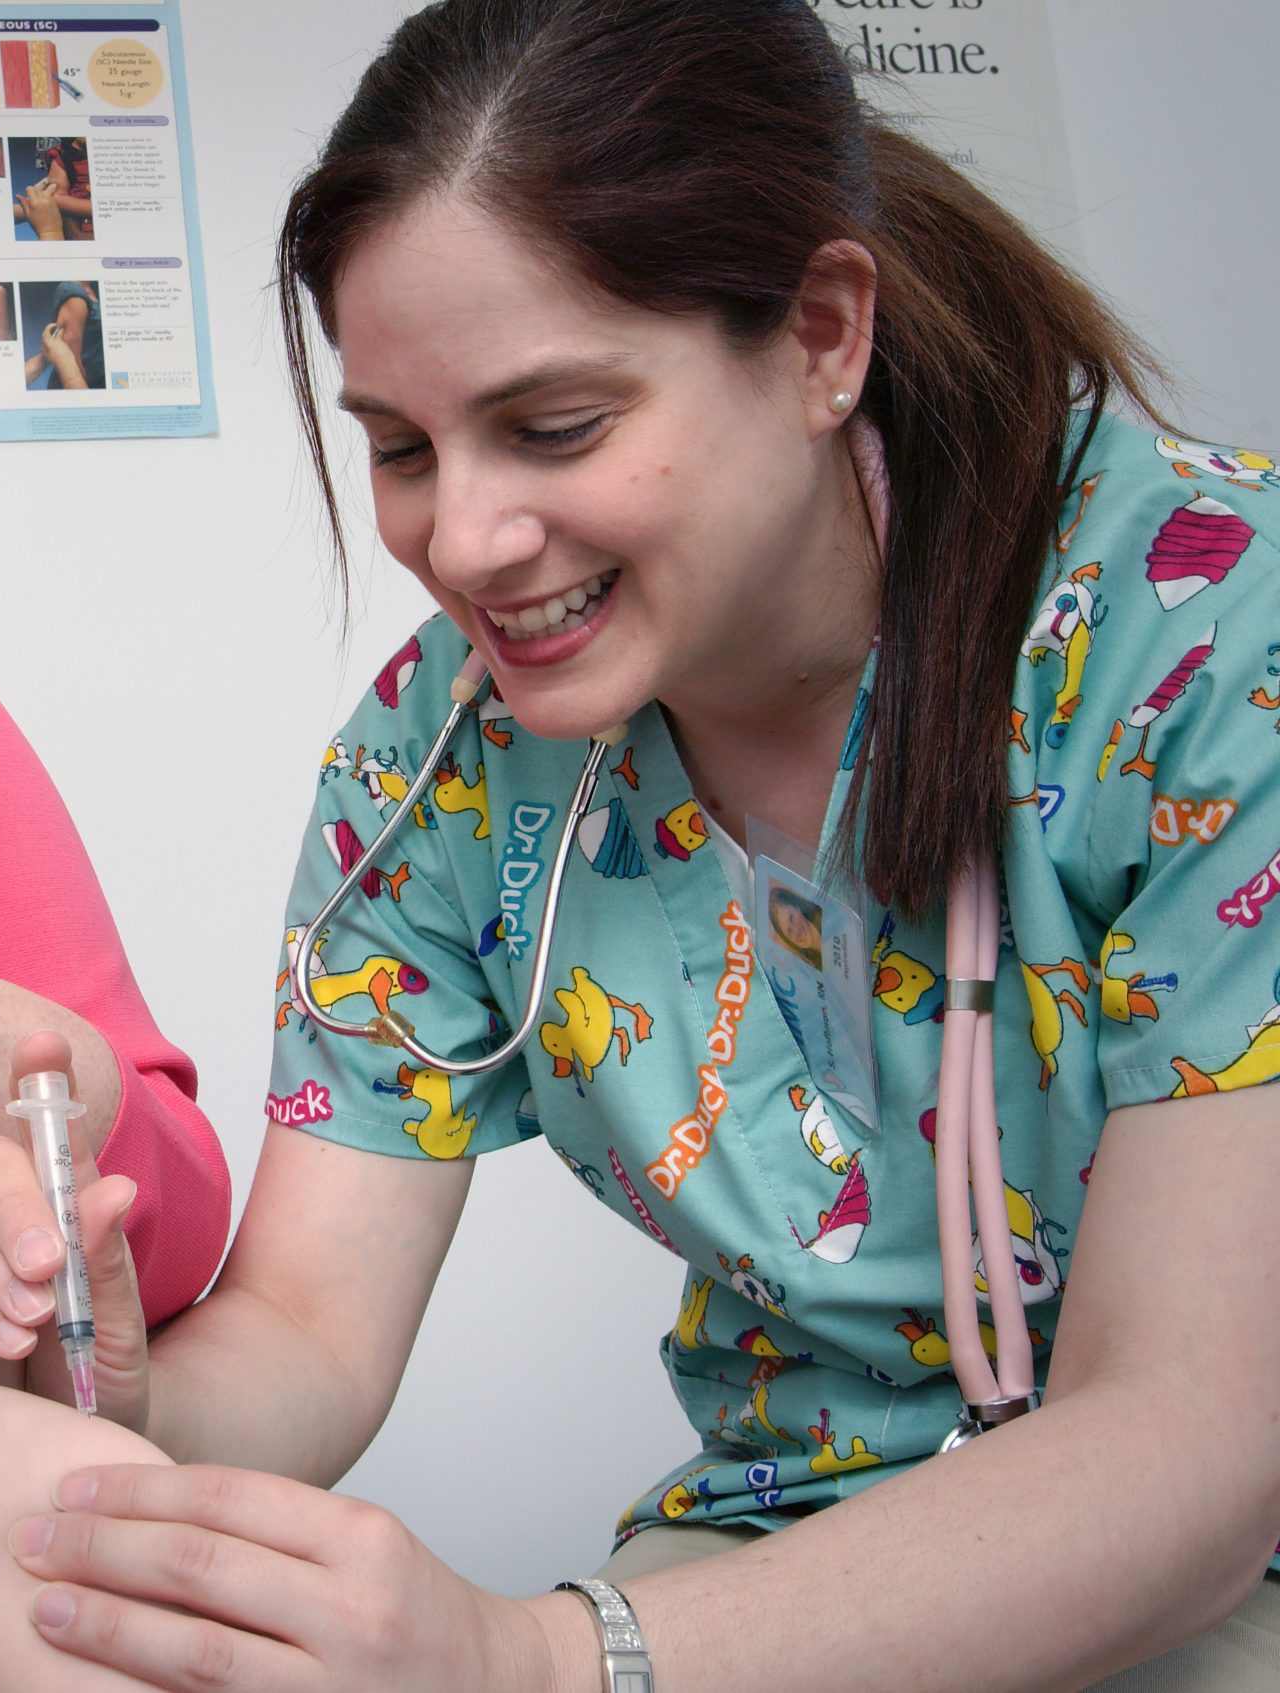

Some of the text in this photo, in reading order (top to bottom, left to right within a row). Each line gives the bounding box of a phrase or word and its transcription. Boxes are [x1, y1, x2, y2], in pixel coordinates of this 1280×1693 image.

[33, 21, 58, 31] (SC)
[121, 68, 142, 76] gauge
[816, 981, 825, 1000] RN
